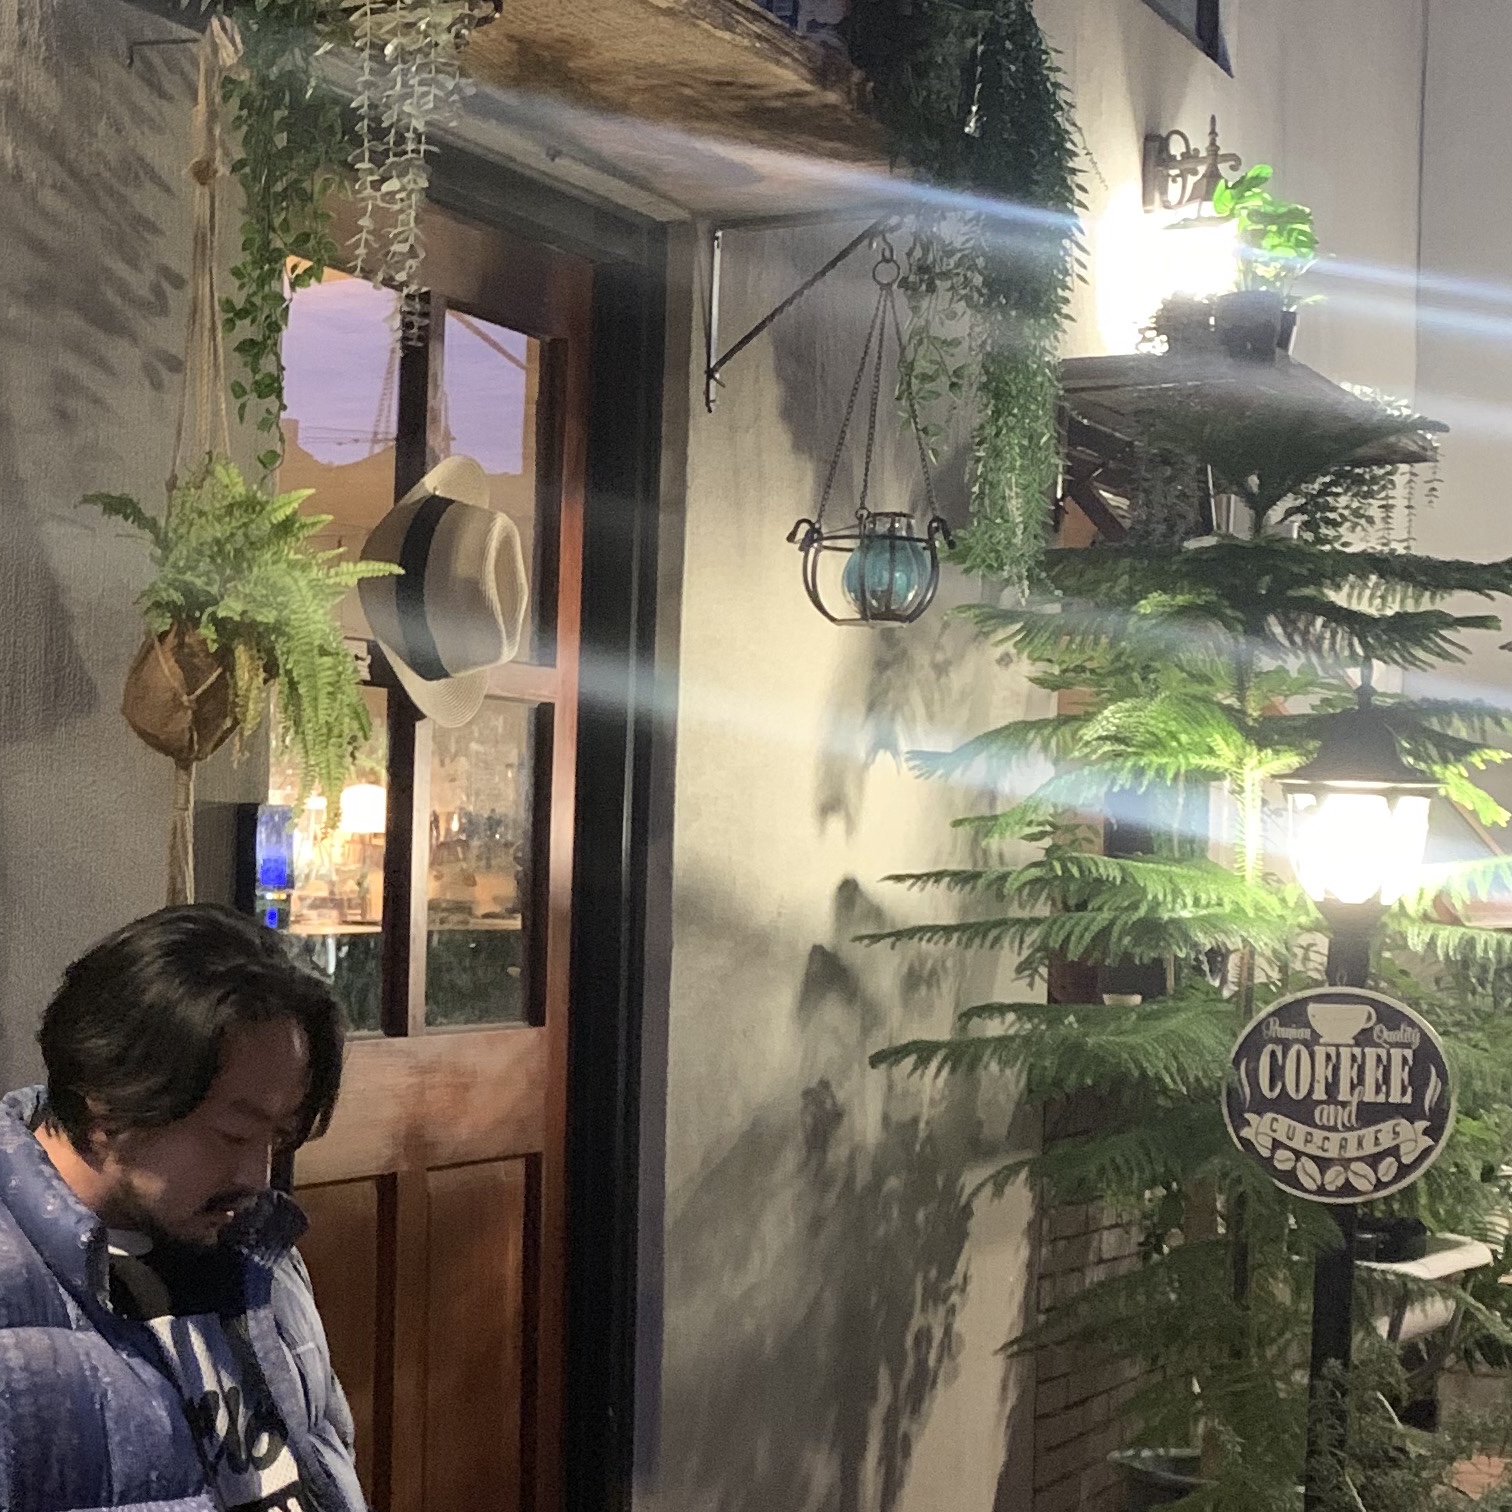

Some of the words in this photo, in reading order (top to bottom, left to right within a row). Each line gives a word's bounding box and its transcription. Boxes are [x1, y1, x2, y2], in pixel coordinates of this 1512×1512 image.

[1373, 1022, 1421, 1050] Quality
[1258, 1043, 1414, 1104] COFFEE
[1314, 1086, 1360, 1130] and
[1268, 1115, 1402, 1156] CUPCAKES
